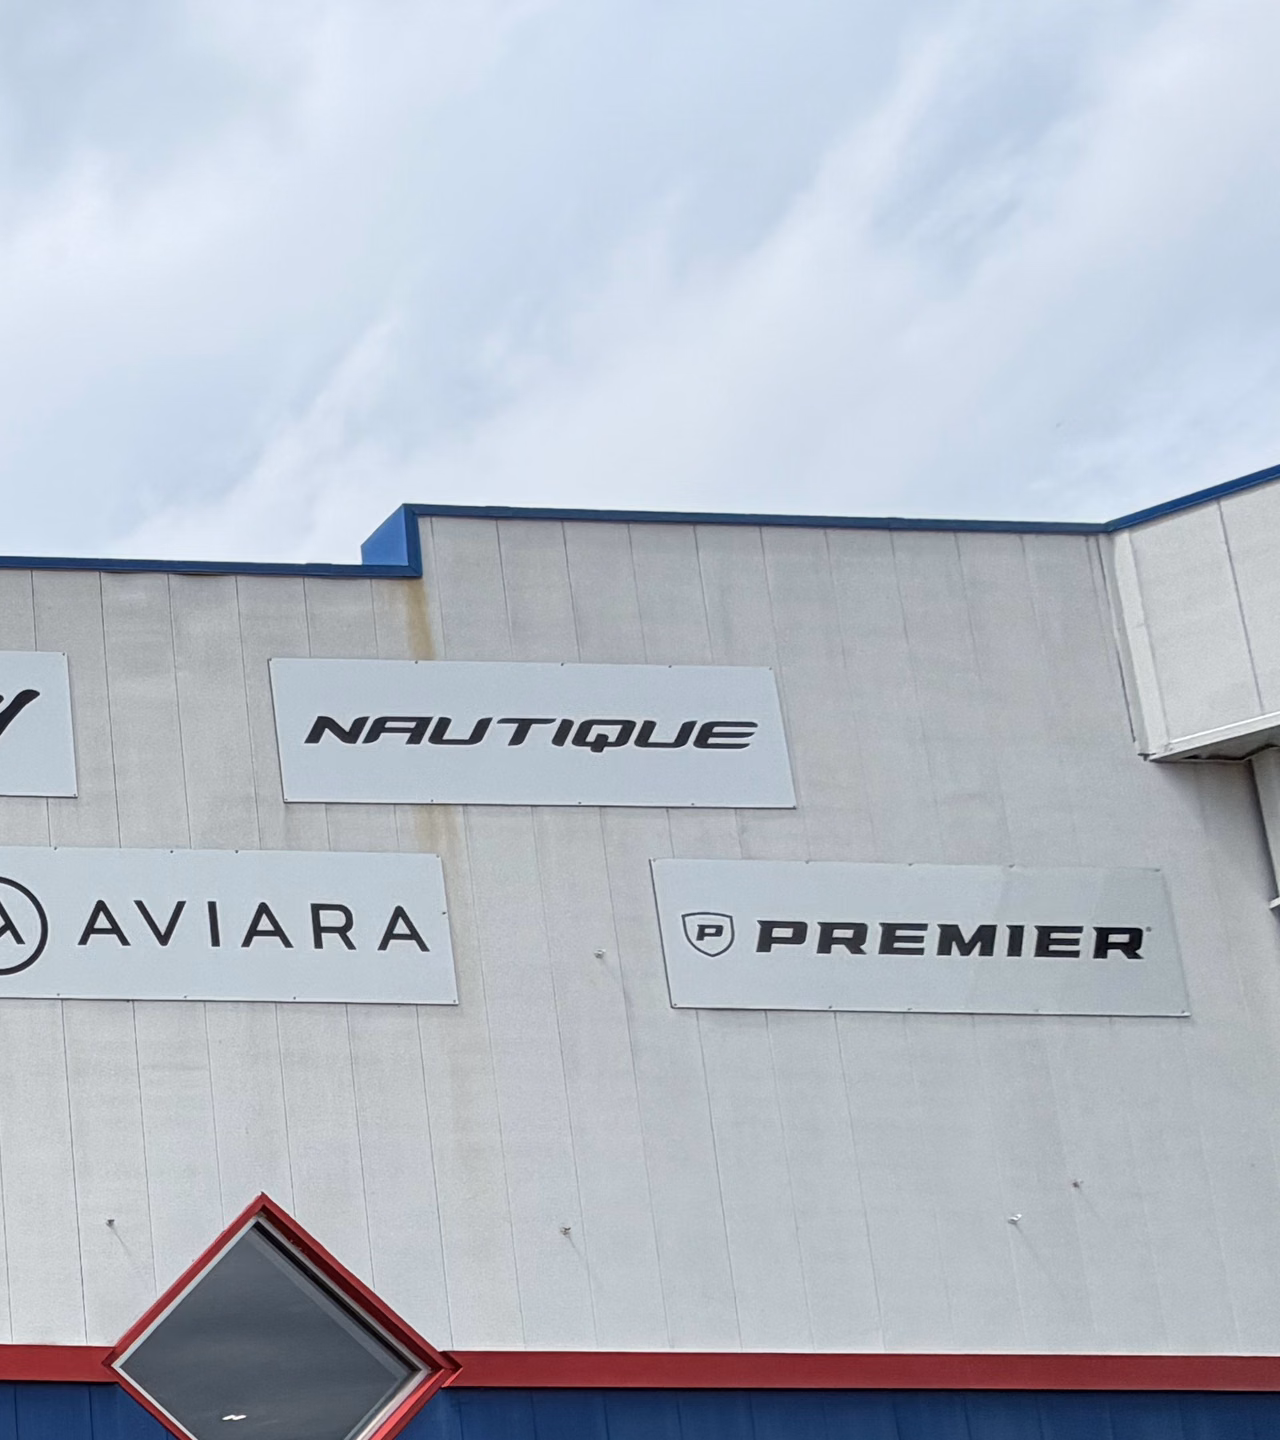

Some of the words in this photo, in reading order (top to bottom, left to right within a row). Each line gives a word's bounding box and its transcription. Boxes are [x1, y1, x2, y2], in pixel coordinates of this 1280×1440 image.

[304, 715, 759, 753] NAUTIQUE
[77, 899, 431, 953] AVIARA
[755, 919, 1145, 960] PREMIER
